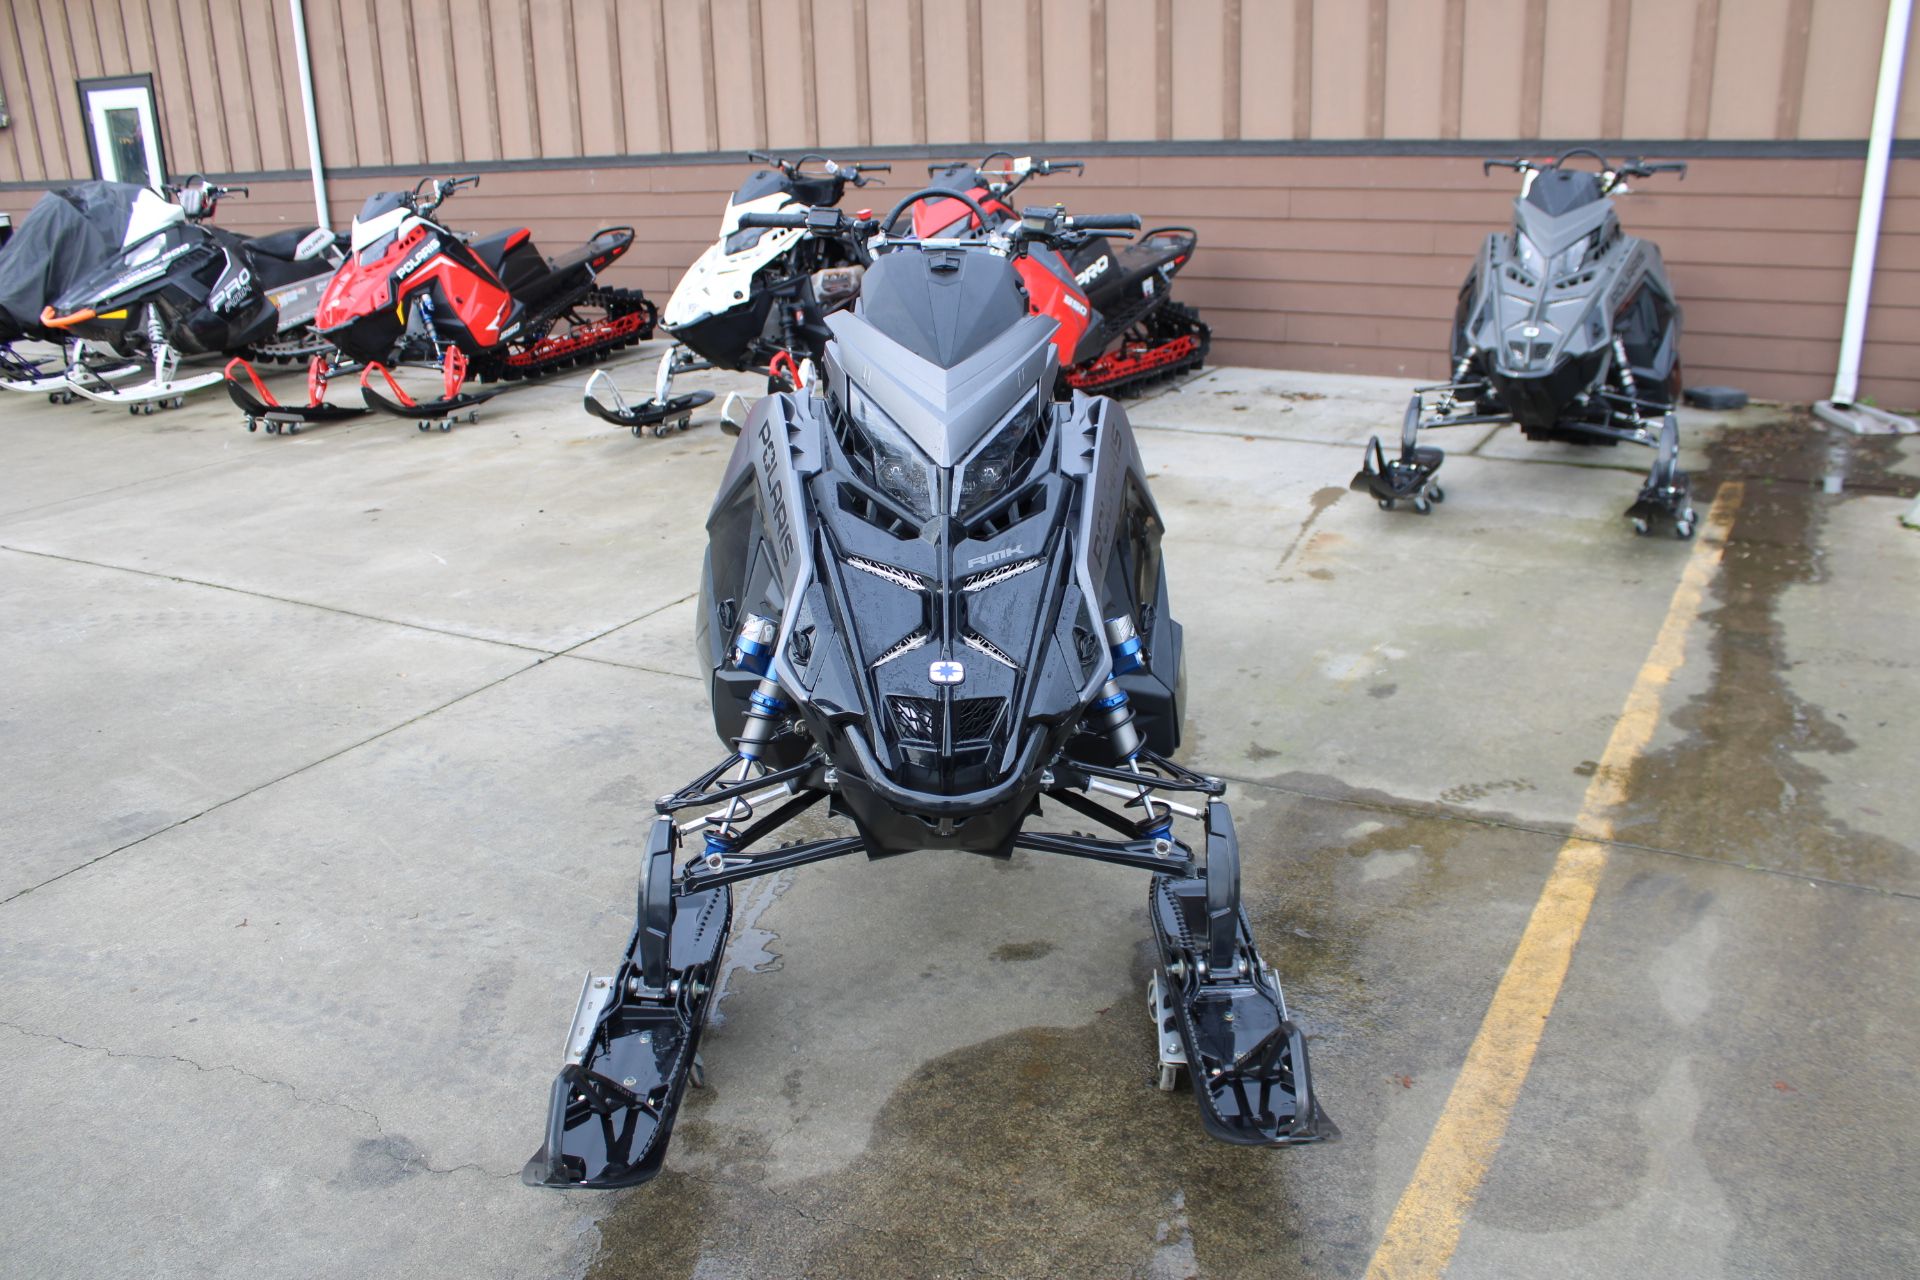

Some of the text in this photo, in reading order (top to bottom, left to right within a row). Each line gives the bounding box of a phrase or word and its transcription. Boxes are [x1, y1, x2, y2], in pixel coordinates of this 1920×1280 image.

[395, 238, 441, 280] POLARIS
[1074, 254, 1109, 286] PRO
[208, 267, 251, 313] PRO
[758, 418, 795, 568] POLARIS
[967, 544, 1025, 569] RMK
